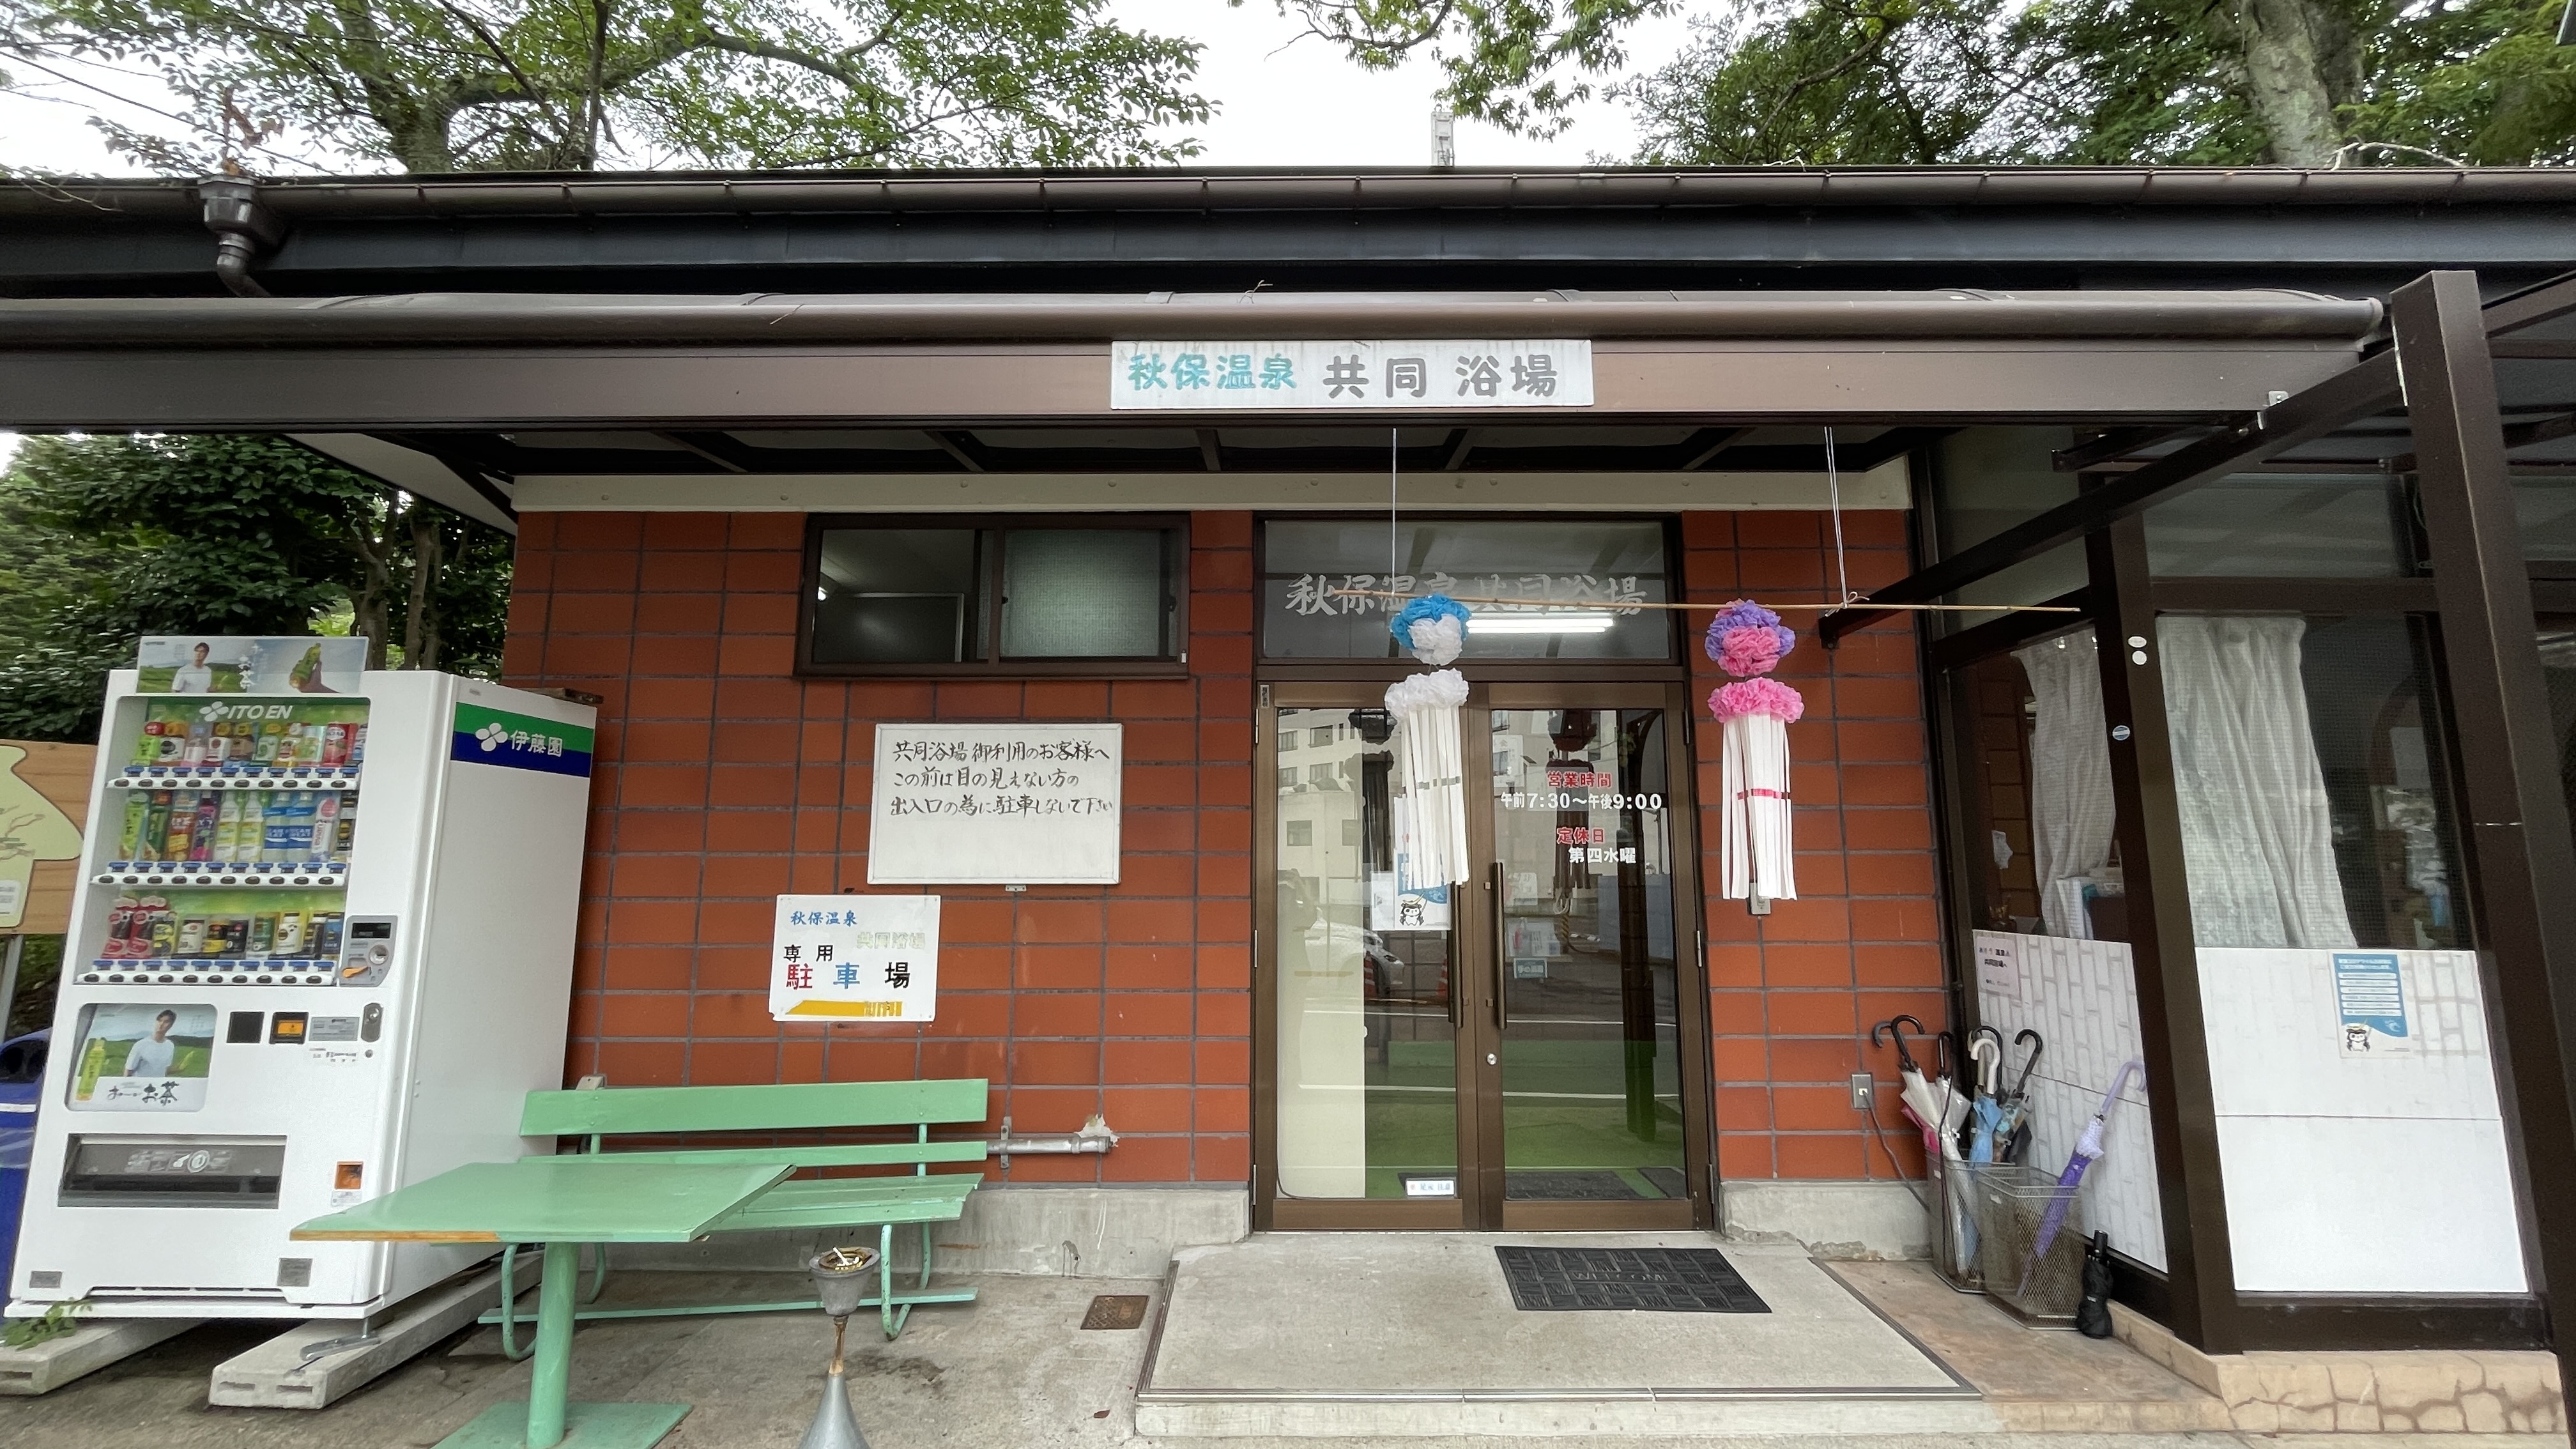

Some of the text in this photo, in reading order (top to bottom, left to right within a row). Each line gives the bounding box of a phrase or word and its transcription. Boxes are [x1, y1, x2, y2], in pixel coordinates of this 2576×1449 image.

[1128, 353, 1297, 391] 秋保温泉
[227, 705, 294, 719] ITO EN
[510, 730, 563, 758] 伊藤園
[894, 766, 1079, 790] この前は目の見えない方の
[1547, 771, 1612, 788] 営業時間
[891, 794, 1114, 818] 出入口の為に駐車しないで下さい
[1556, 827, 1606, 845] 定休日
[1568, 847, 1636, 864] 第四水曜
[790, 910, 857, 927] 秋保温泉
[783, 944, 833, 962] 専用
[786, 961, 910, 990] 駐車場
